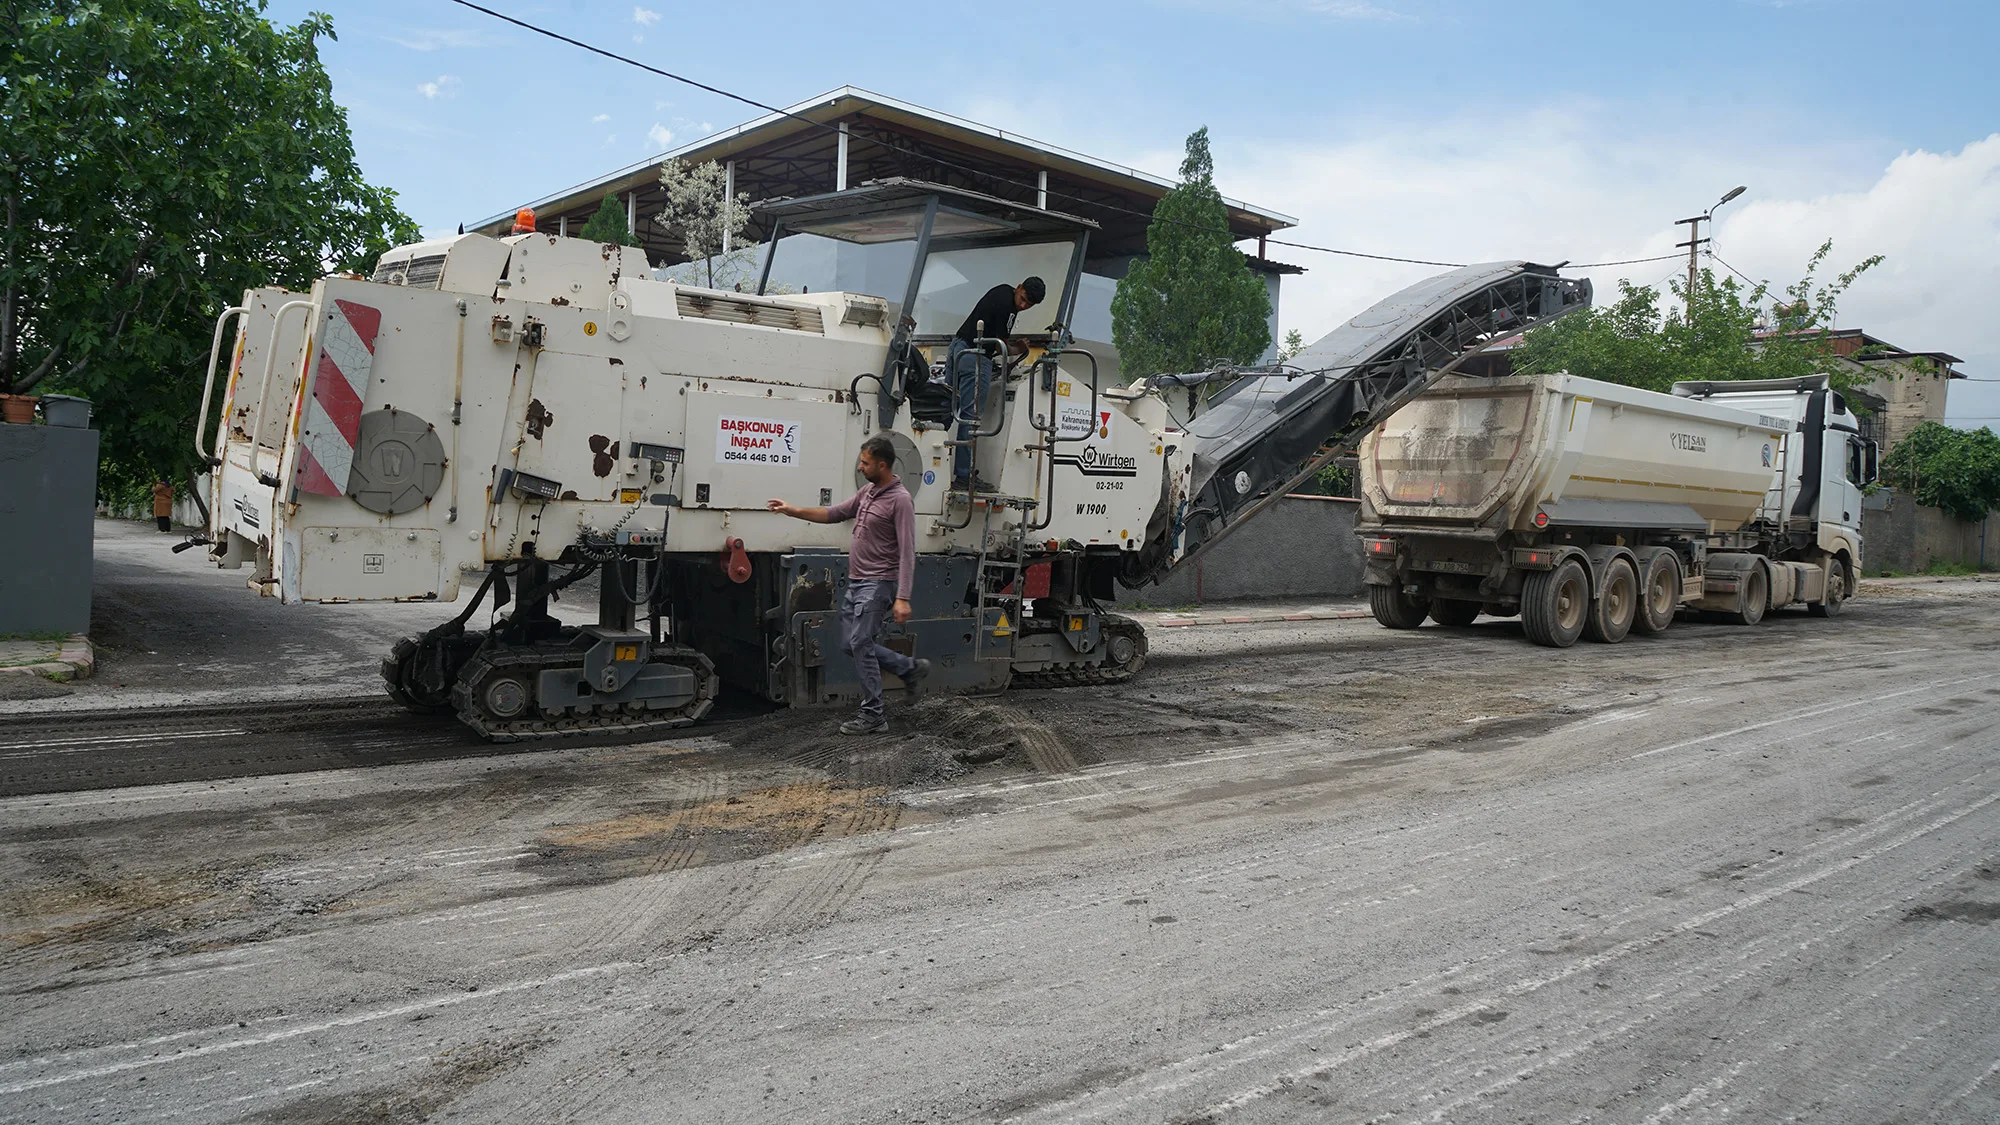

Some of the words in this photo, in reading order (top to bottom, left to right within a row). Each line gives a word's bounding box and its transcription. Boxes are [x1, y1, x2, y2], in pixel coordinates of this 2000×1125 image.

[720, 419, 785, 437] BAŞKONUŞ
[730, 434, 773, 451] İNŞAAT
[724, 451, 747, 461] 0544
[750, 453, 767, 462] 446
[769, 454, 779, 463] 10
[1098, 454, 1135, 469] Wirtgen
[1095, 481, 1124, 490] 02-21-02
[1076, 503, 1085, 515] W
[1086, 503, 1107, 515] 1900
